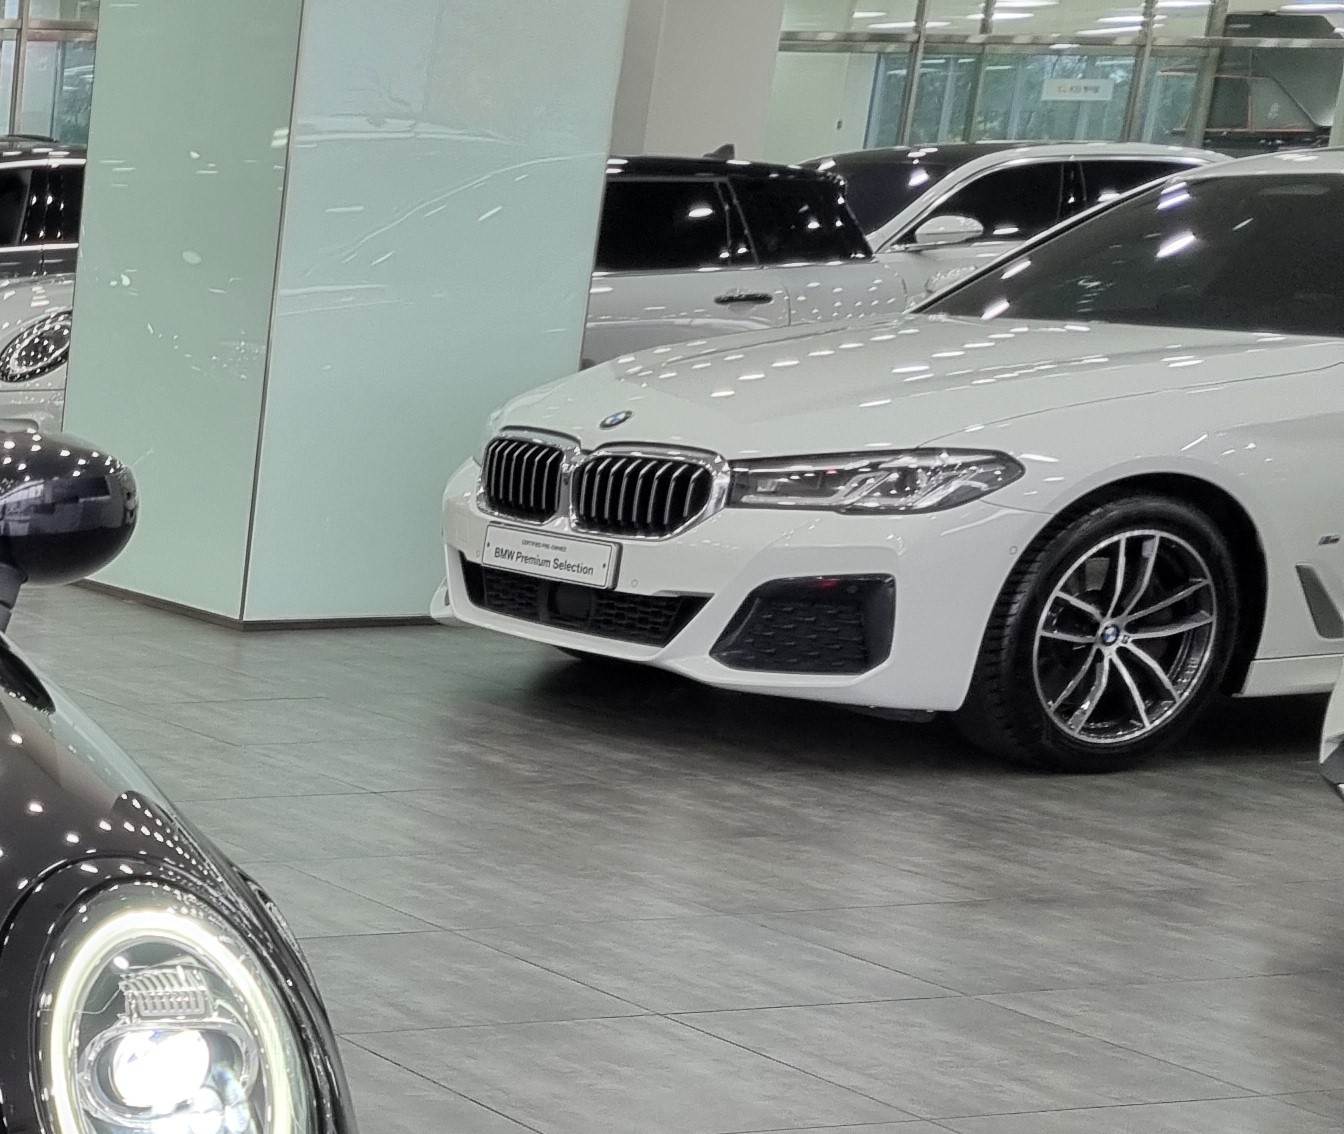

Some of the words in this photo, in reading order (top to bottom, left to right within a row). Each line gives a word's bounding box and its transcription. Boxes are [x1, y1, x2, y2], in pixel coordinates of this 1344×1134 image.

[494, 547, 515, 561] BMW
[515, 551, 551, 568] Premium
[552, 558, 594, 576] Selection
